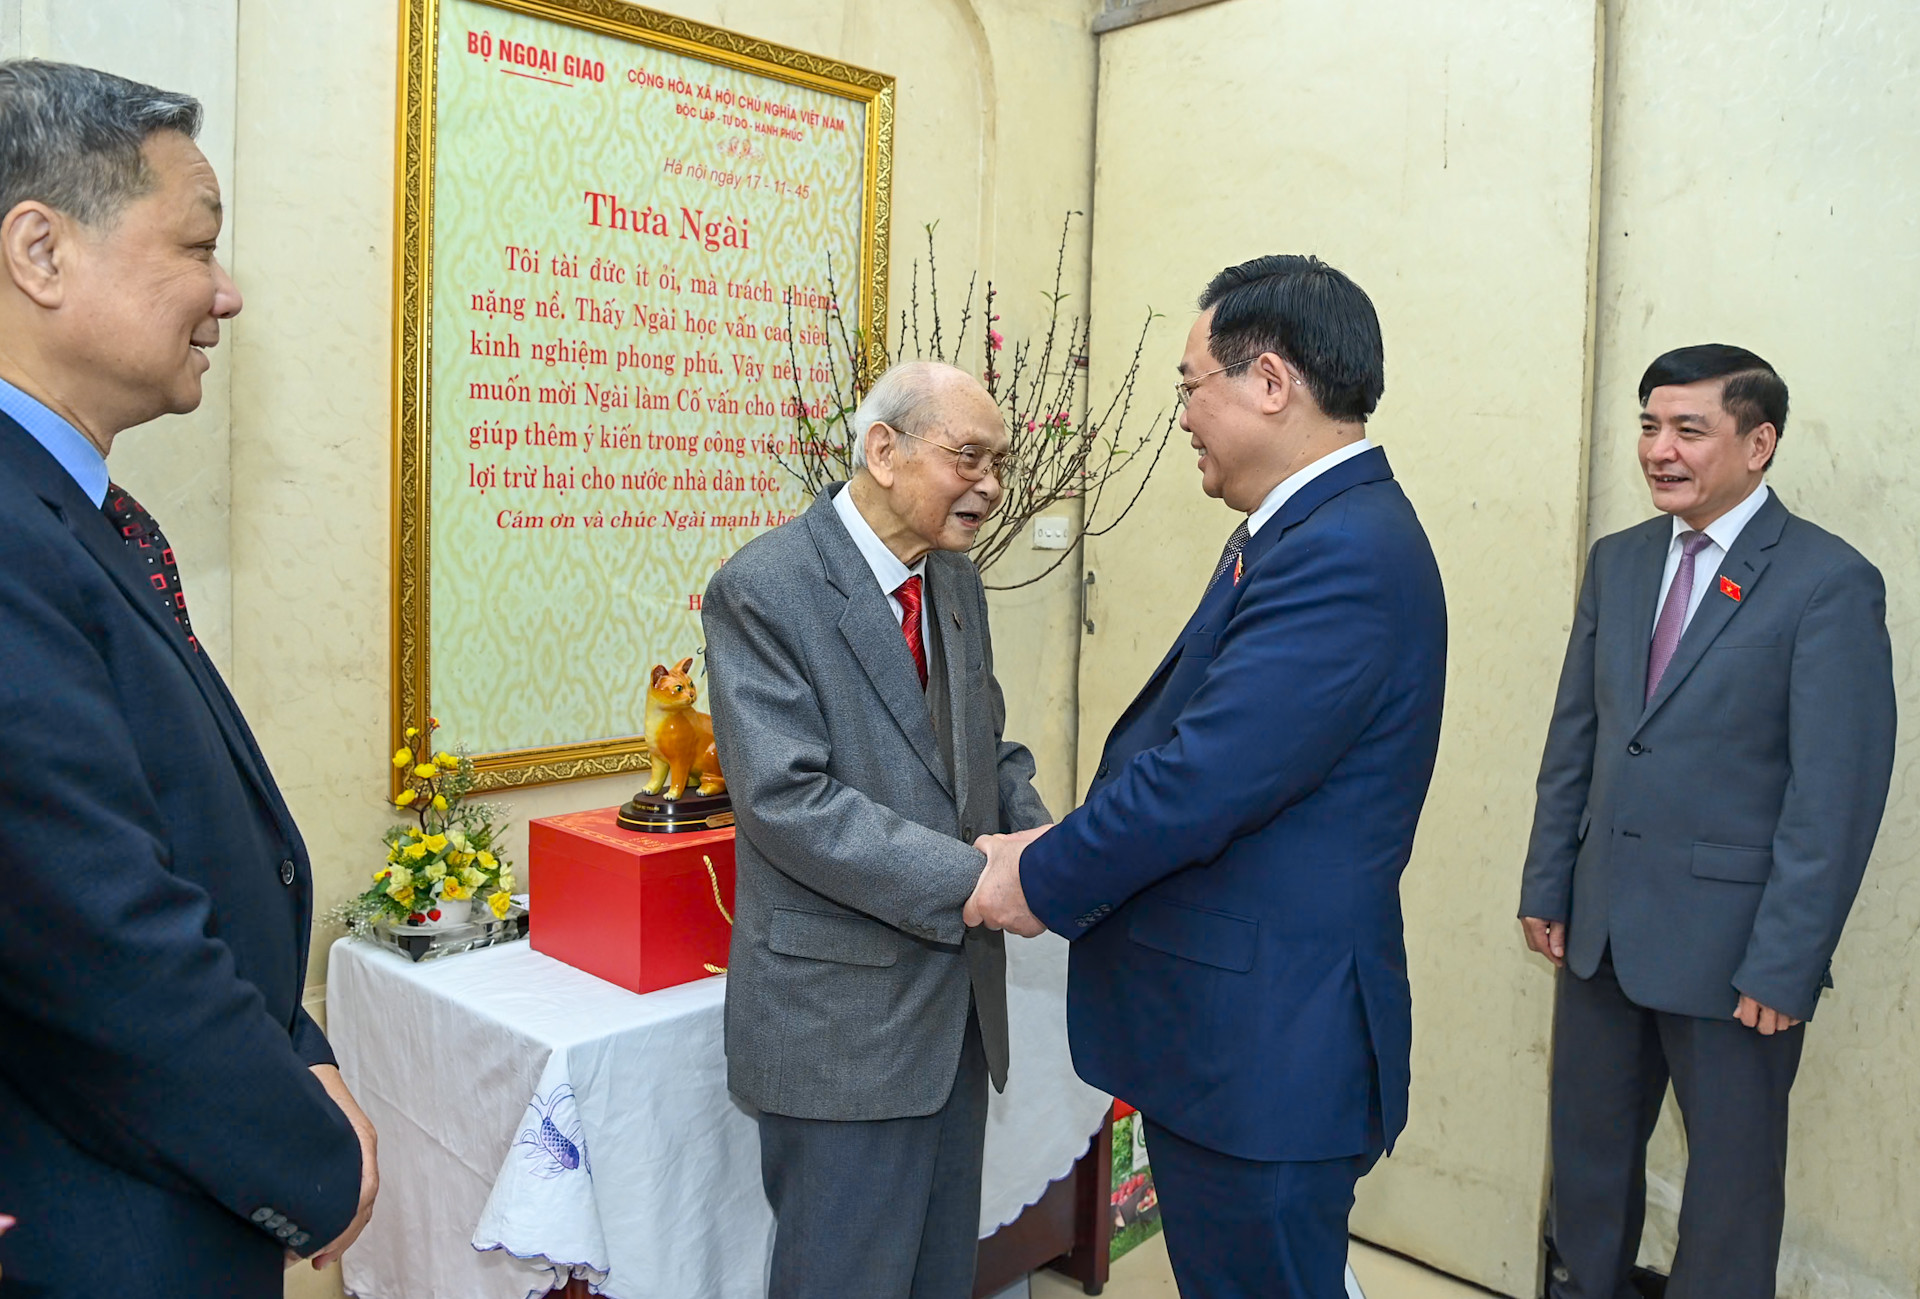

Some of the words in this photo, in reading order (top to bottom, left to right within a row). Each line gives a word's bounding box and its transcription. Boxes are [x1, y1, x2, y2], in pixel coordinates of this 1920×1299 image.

[467, 30, 492, 62] BỘ
[499, 39, 557, 75] NGOẠI
[563, 55, 605, 82] GIAO
[628, 68, 664, 89] CỘNG
[668, 76, 693, 97] HÒA
[696, 84, 712, 101] XÃ
[715, 88, 735, 109] HỘI
[738, 95, 761, 112] CHỦ
[764, 102, 797, 121] NGHĨA
[800, 109, 820, 128] VIỆT
[822, 116, 845, 132] NAM
[676, 102, 697, 119] ĐỘC
[699, 107, 716, 124] LẬP
[723, 114, 733, 129] TỰ
[735, 117, 748, 129] DO
[755, 121, 778, 137] HẠNH
[780, 127, 803, 142] PHÚC
[664, 157, 683, 175] Hà
[686, 164, 707, 182] nội
[710, 170, 742, 189] ngày
[746, 174, 761, 190] 17
[795, 184, 810, 200] 45
[584, 191, 669, 237] Thưa
[679, 207, 749, 252] Ngài
[505, 246, 540, 274] Tôi
[551, 253, 579, 278] tài
[590, 257, 626, 284] đức
[635, 263, 650, 287] ít
[659, 264, 681, 295] ỏi,
[691, 273, 718, 296] mà
[728, 279, 773, 303] trách
[471, 289, 526, 322] nặng
[535, 290, 565, 320] nề.
[575, 297, 625, 331] Thấy
[633, 304, 676, 335] Ngài
[685, 310, 717, 340] học
[725, 314, 757, 339] vấn
[764, 325, 791, 343] cao
[470, 330, 520, 358] kinh
[531, 338, 608, 371] nghiệm
[616, 344, 676, 377] phong
[684, 350, 724, 378] phú.
[732, 354, 765, 383] Vậy
[773, 359, 802, 382] nên
[810, 362, 830, 383] tôi
[469, 374, 531, 402] muốn
[538, 380, 577, 405] mời
[584, 383, 629, 413] Ngài
[635, 386, 670, 410] làm
[677, 387, 703, 413] Cố
[707, 389, 739, 414] vấn
[745, 395, 775, 417] cho
[781, 397, 800, 418] tô
[469, 420, 518, 450] giúp
[525, 422, 577, 447] thêm
[584, 424, 594, 453] ý
[600, 424, 642, 450] kiến
[648, 430, 699, 456] trong
[704, 430, 746, 458] công
[752, 433, 784, 460] việc
[469, 463, 496, 495] lợi
[503, 465, 538, 489] trừ
[543, 465, 575, 496] hại
[582, 466, 615, 490] cho
[621, 468, 667, 491] nước
[674, 468, 707, 491] nhà
[713, 469, 745, 492] dân
[751, 470, 780, 498] tộc.
[496, 510, 544, 529] Cám
[551, 513, 576, 529] ơn
[584, 511, 604, 528] và
[610, 510, 657, 529] chúc
[662, 511, 706, 531] Ngài
[711, 511, 760, 532] mạnh
